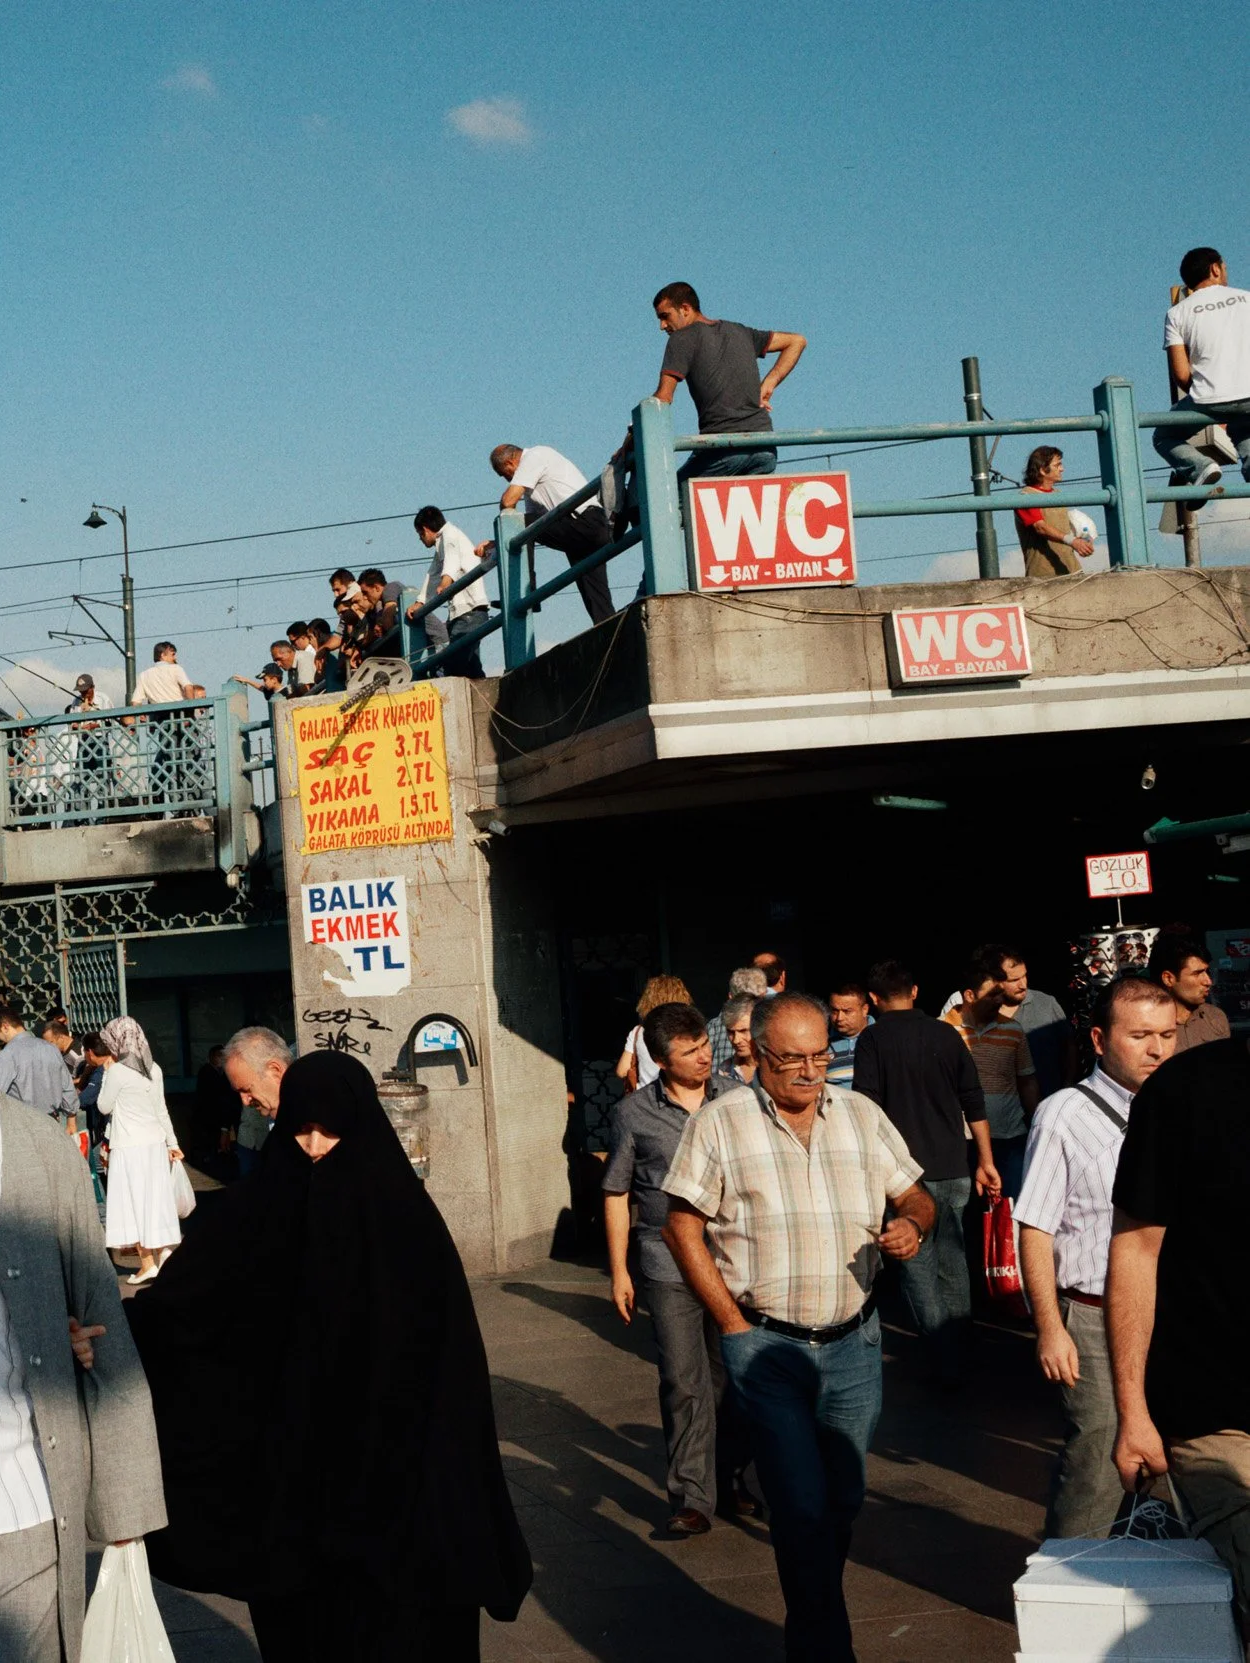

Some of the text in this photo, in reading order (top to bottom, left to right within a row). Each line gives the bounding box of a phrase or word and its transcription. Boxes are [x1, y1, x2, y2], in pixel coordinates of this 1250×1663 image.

[697, 481, 845, 561] WC
[731, 565, 759, 582] BAY
[775, 561, 823, 580] BAYAN
[899, 612, 1006, 663] WC
[909, 663, 940, 677] BAY
[954, 660, 1008, 674] BAYAN
[300, 694, 435, 743] GALATA ERKEK KUAFÖRÜ
[304, 741, 375, 769] SAÇ
[309, 773, 372, 806] SAKAL
[307, 803, 379, 834] YIKAMA
[309, 819, 450, 850] GALATA KÖPRÜSÜ ALTINDA
[309, 881, 397, 913] BALIK
[311, 911, 400, 944] EKMEK
